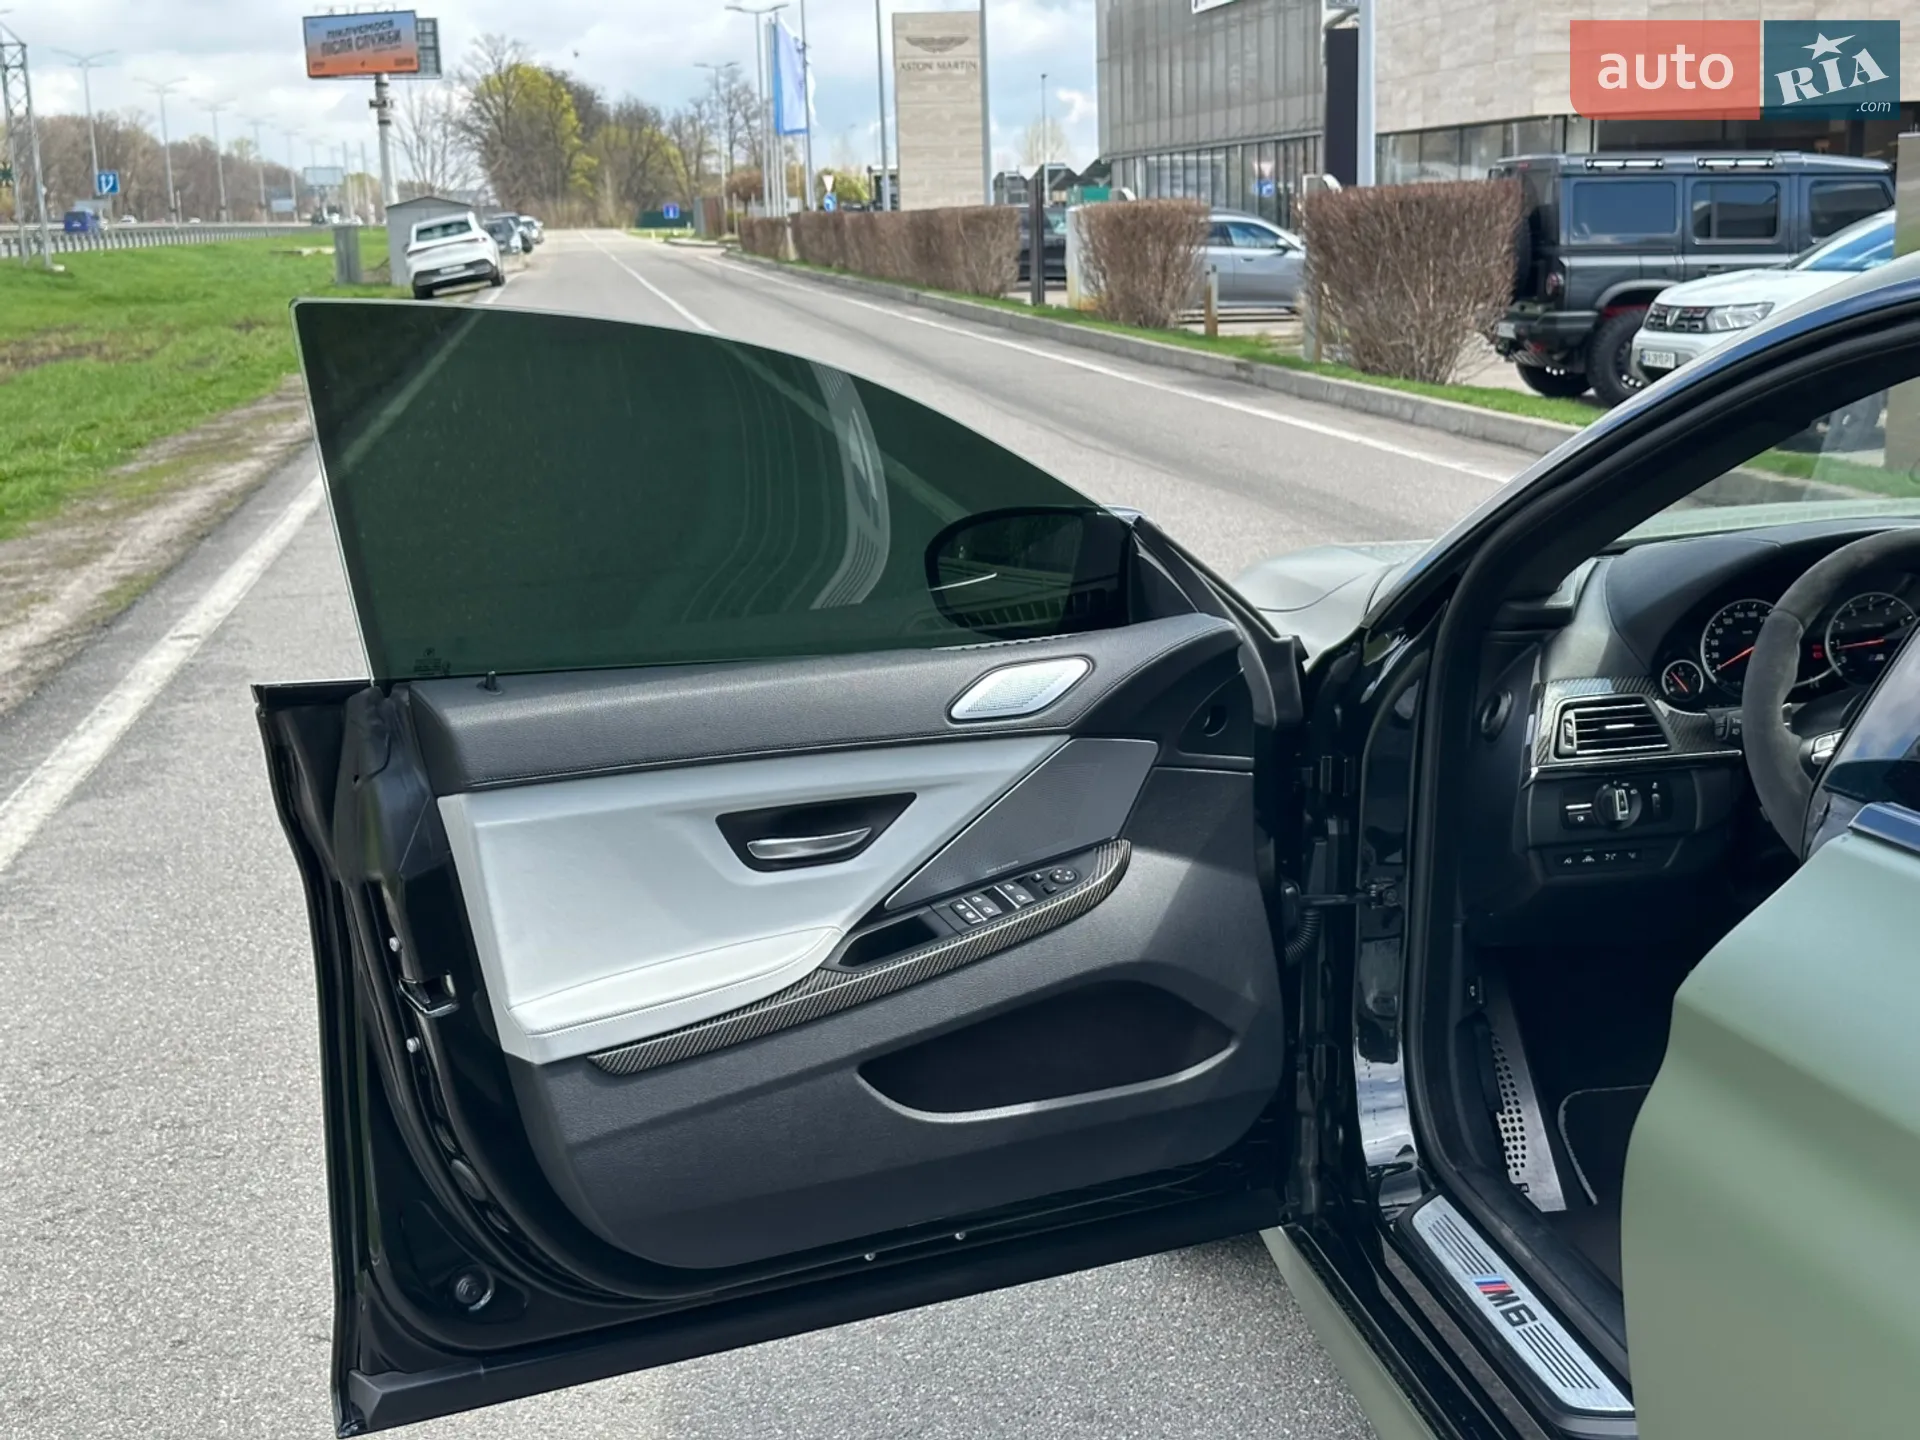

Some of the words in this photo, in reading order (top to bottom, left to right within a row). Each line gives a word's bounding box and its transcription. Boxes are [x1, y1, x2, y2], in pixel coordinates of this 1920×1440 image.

[900, 61, 933, 71] ASTON
[936, 60, 977, 70] MARTIN
[1480, 1288, 1539, 1327] M6
